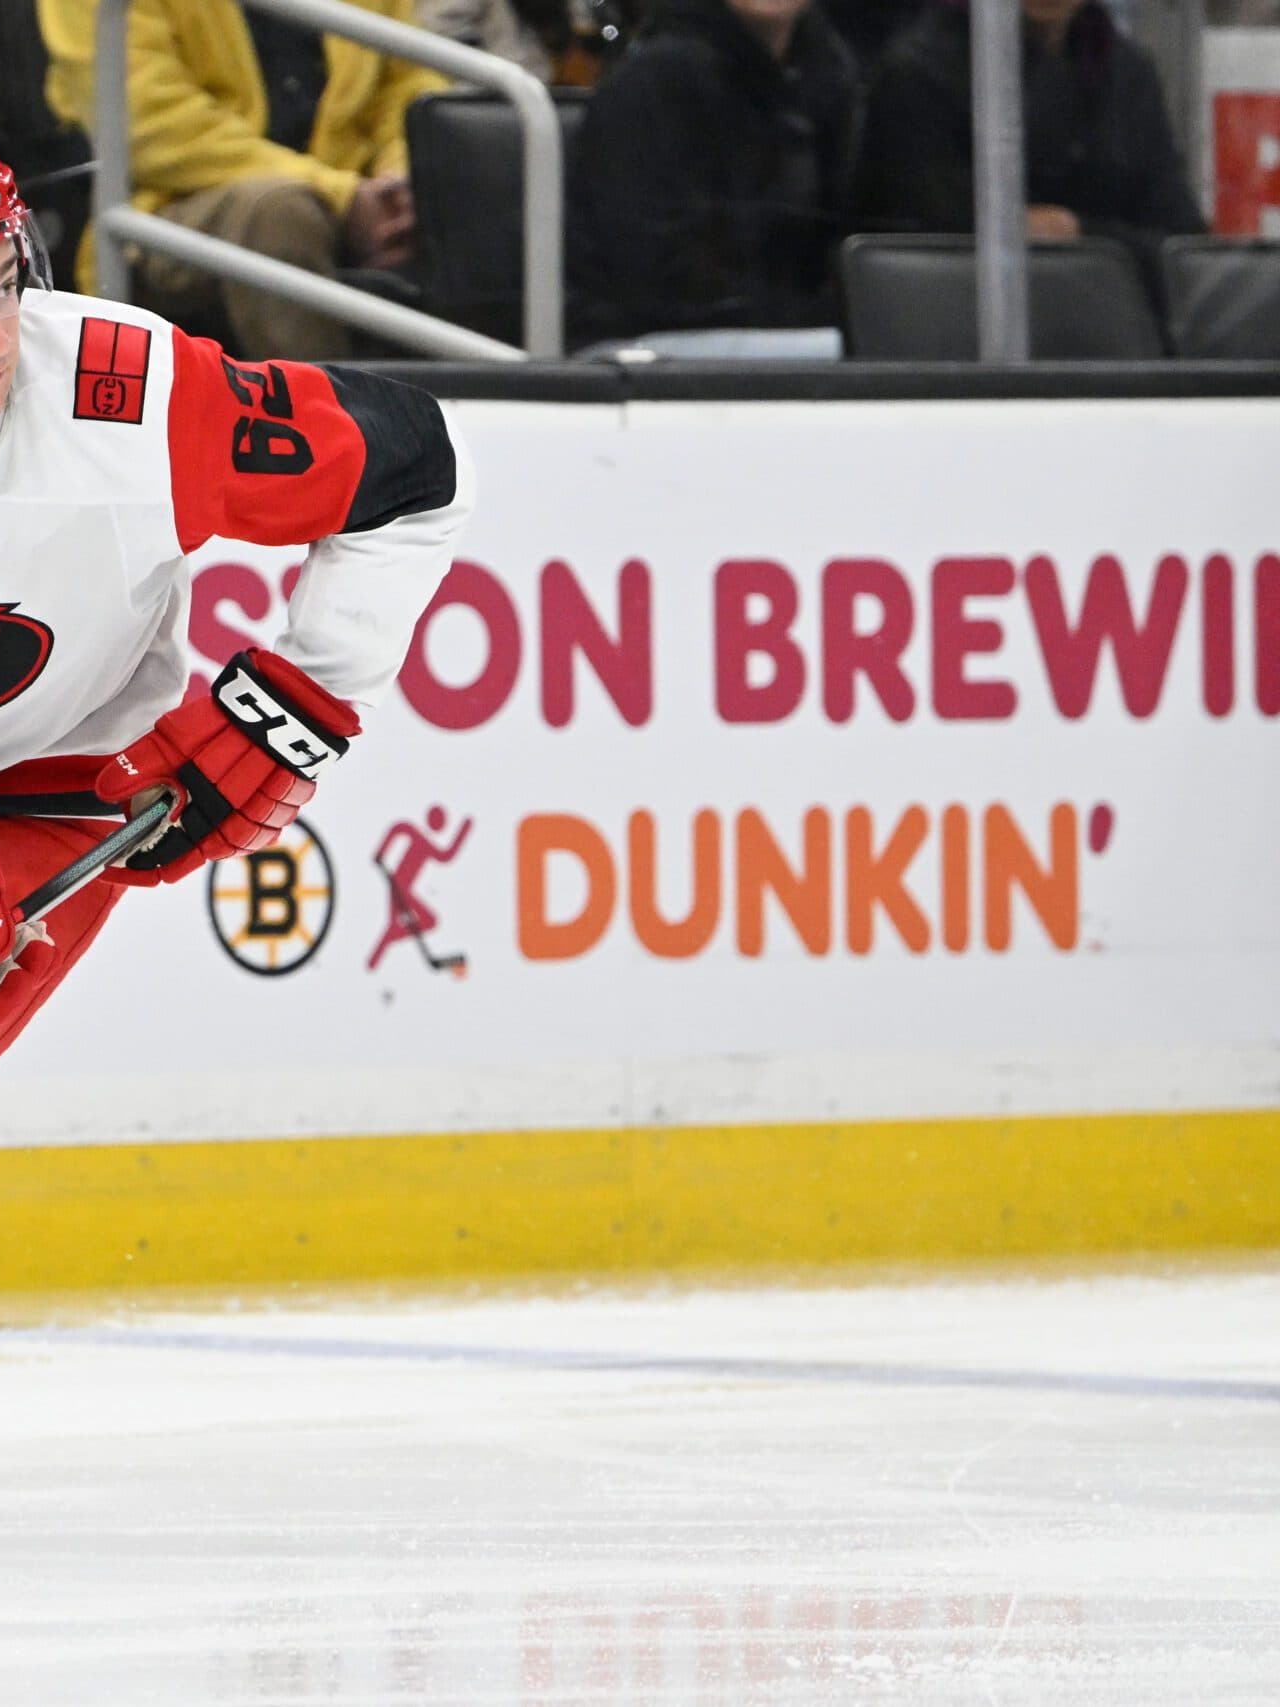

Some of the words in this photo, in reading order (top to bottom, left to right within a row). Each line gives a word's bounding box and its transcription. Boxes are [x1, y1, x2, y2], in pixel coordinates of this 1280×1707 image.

[223, 362, 315, 475] 62
[187, 556, 654, 732] SON
[713, 551, 1280, 725] BREWI
[219, 667, 342, 779] CC
[247, 850, 298, 936] B
[516, 799, 1115, 963] DUNKIN'
